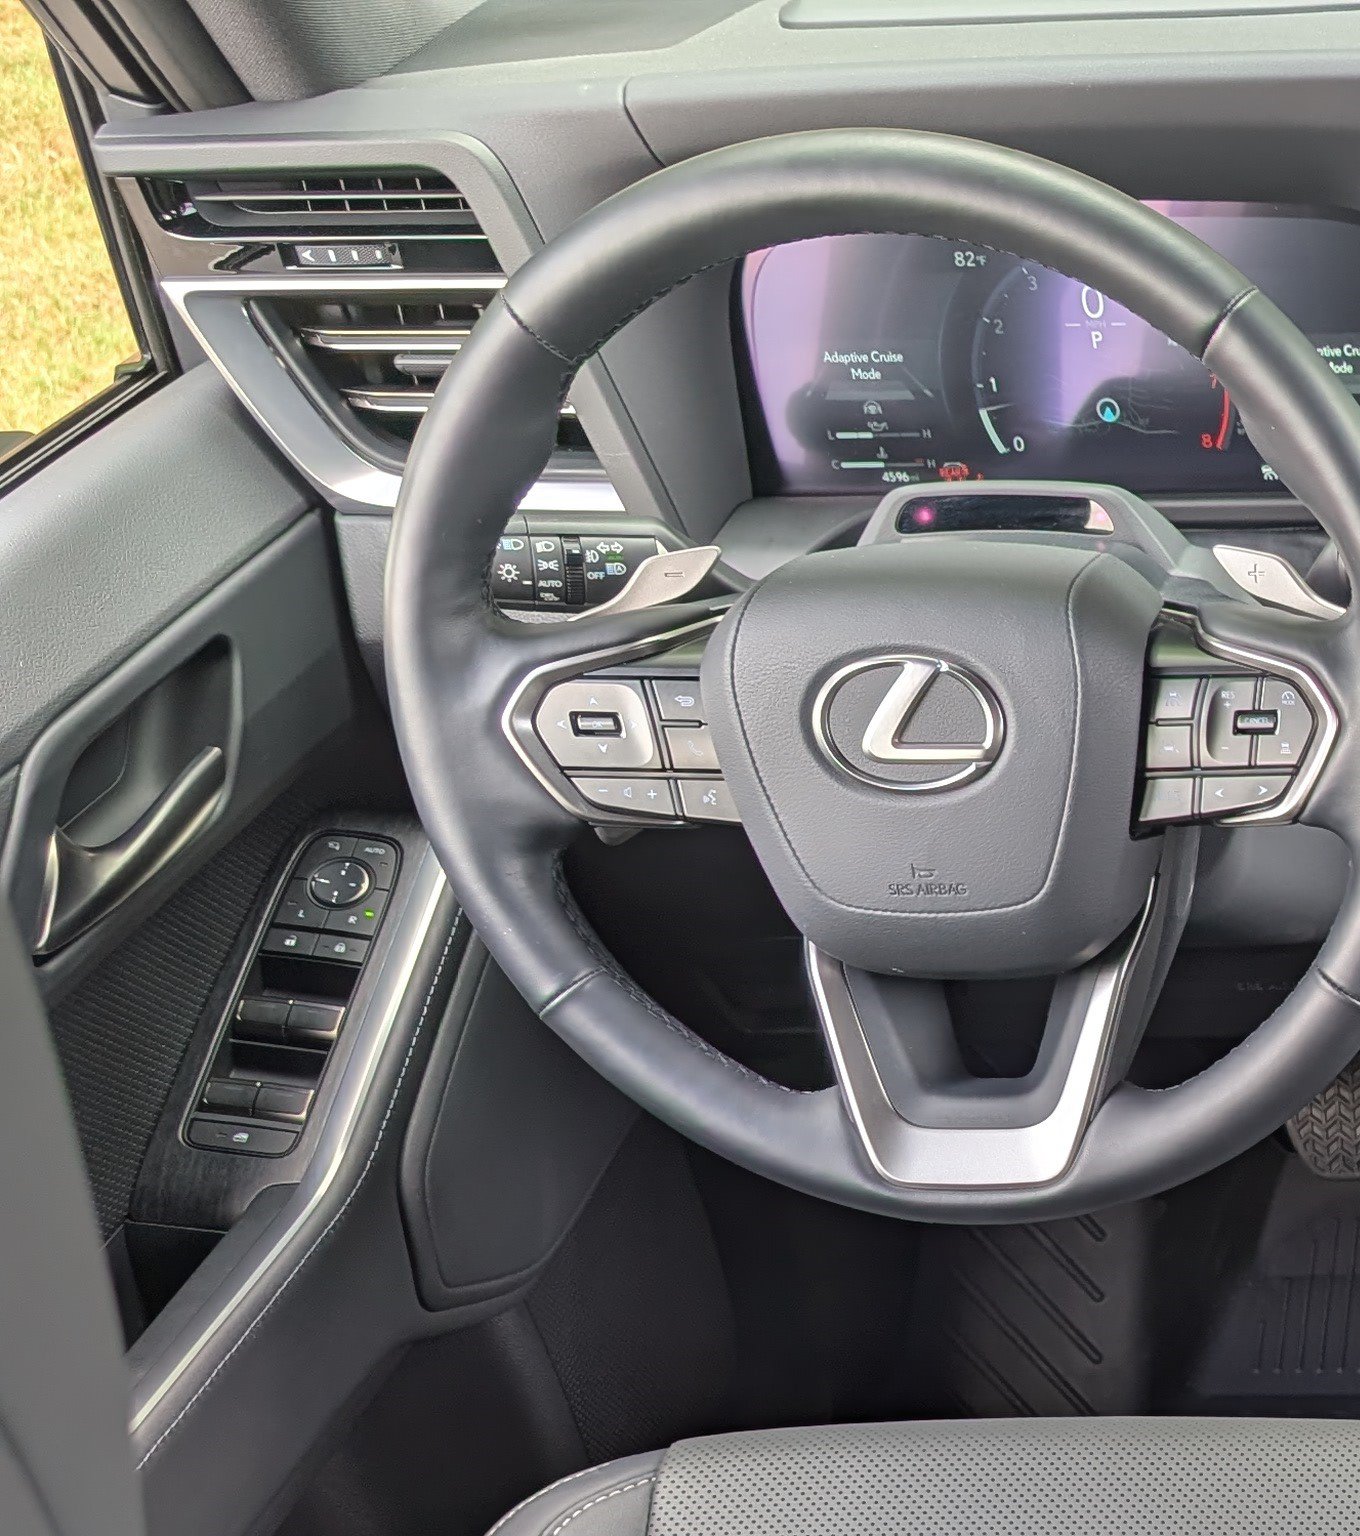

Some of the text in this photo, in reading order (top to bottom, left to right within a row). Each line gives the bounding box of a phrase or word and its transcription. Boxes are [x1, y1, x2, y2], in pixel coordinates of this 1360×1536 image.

[1027, 276, 1038, 291] 3
[1082, 285, 1104, 319] 0
[994, 320, 1004, 334] 2
[1091, 331, 1103, 349] P
[824, 351, 903, 365] Adaptive Cruise
[851, 368, 881, 380] Mode
[989, 377, 998, 392] 1
[1013, 436, 1024, 451] 0
[1202, 433, 1213, 448] 8
[587, 571, 605, 580] OFF
[538, 579, 563, 589] AUTO
[888, 883, 967, 897] SRS AIRBAG
